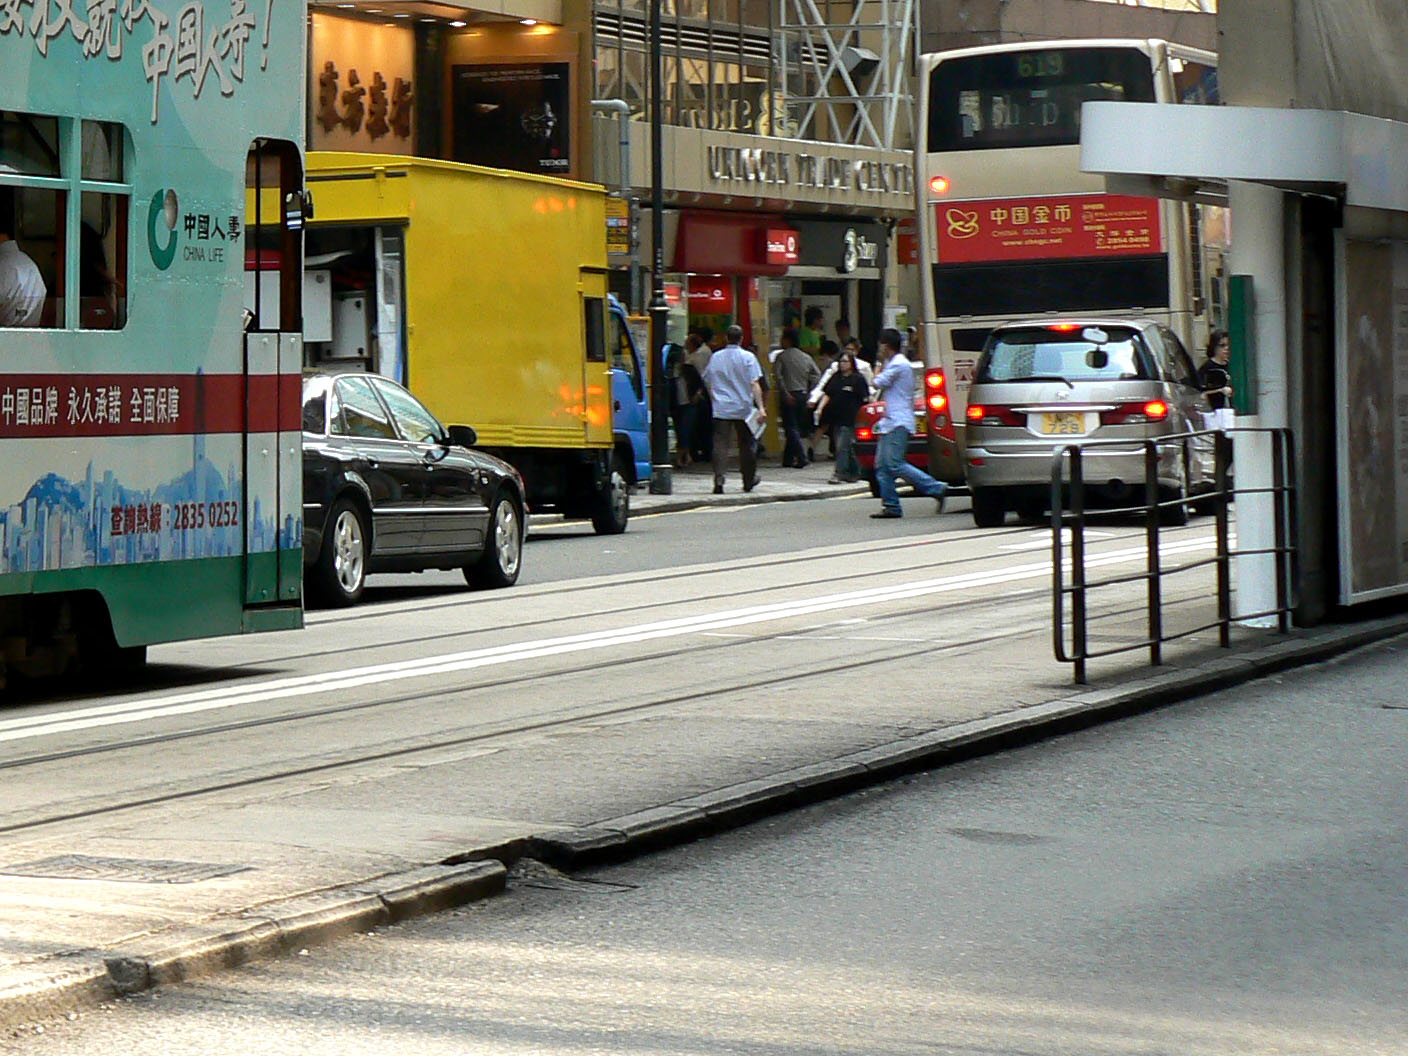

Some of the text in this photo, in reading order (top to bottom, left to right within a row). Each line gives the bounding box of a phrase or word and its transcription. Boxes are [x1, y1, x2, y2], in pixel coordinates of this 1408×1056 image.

[183, 246, 224, 262] CHINA LIFE
[2, 385, 179, 426] 中國品牌 永久承諾 全面保障
[174, 503, 205, 530] 2835
[209, 501, 238, 528] 0252
